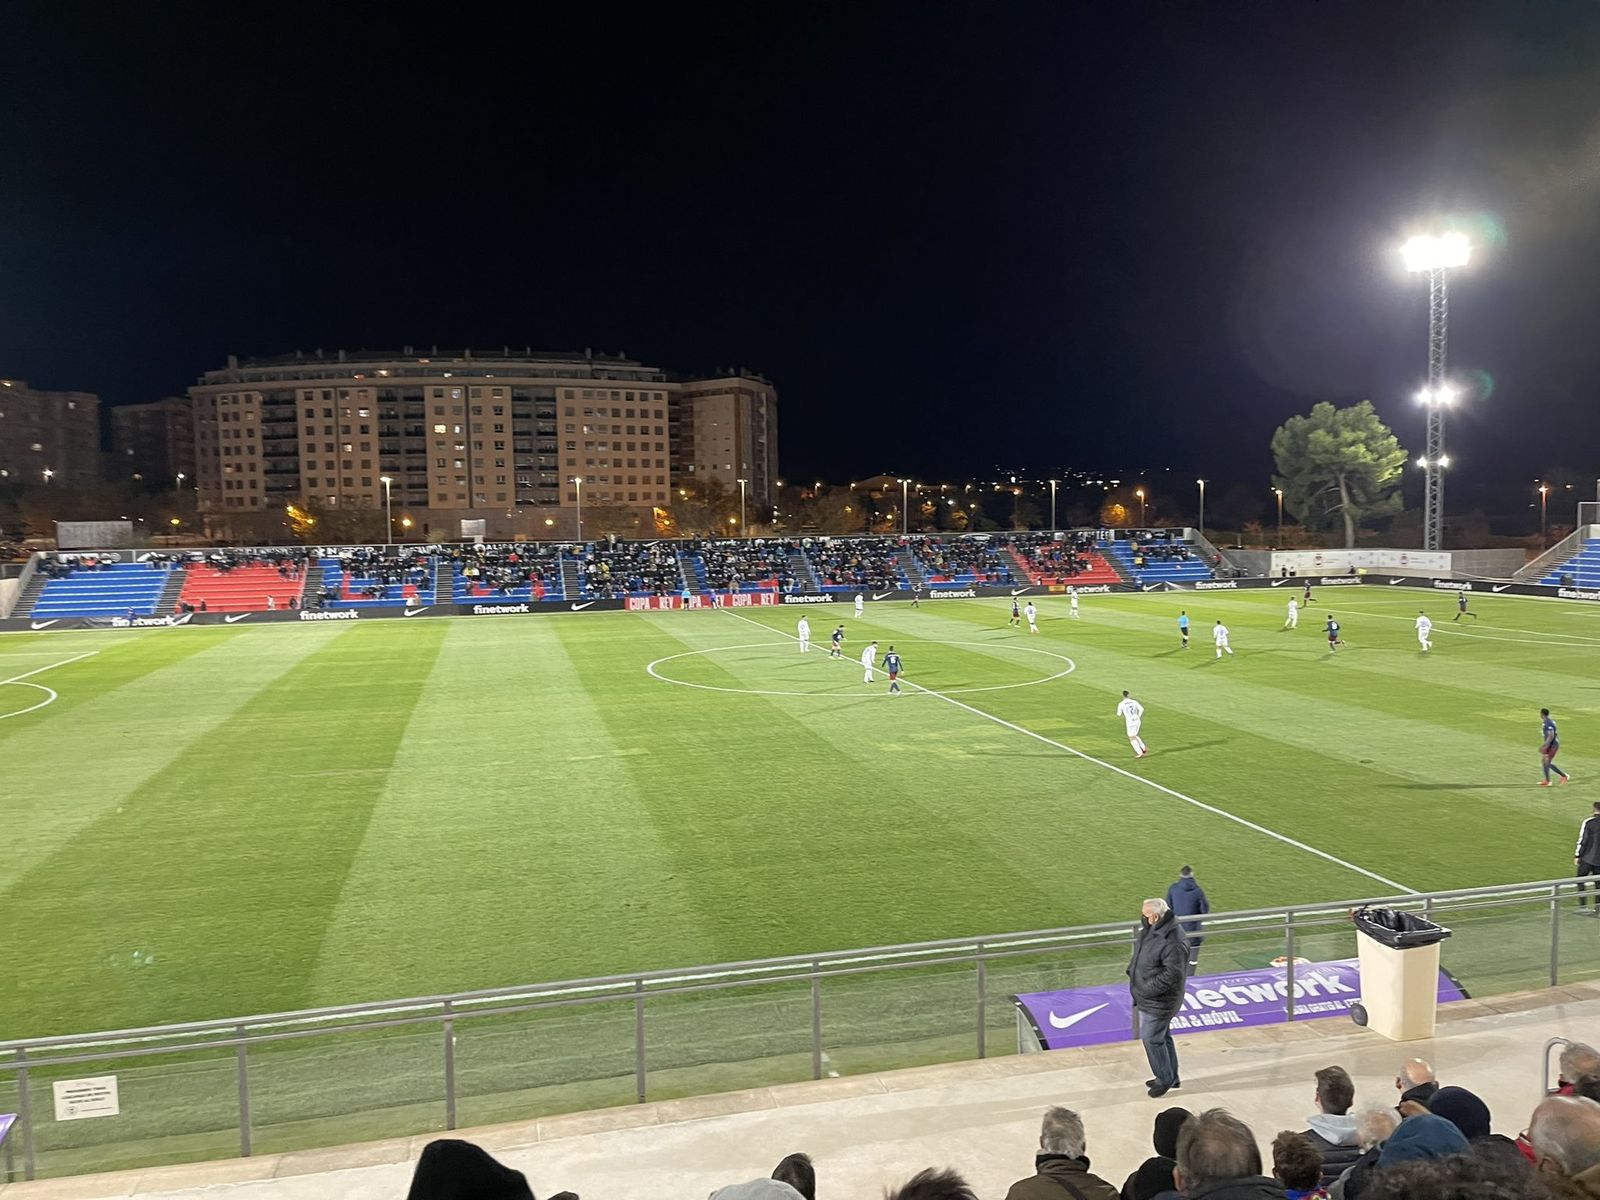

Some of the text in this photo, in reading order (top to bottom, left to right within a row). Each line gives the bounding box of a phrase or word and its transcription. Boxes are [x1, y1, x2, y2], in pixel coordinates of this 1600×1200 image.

[1195, 580, 1238, 590] finetwork
[1320, 576, 1362, 586] finetwork
[1433, 579, 1473, 591] finetwork
[784, 593, 833, 604] finetwork
[929, 588, 977, 599] finetwork
[629, 597, 650, 611] COPA
[688, 595, 702, 609] OPA
[732, 593, 753, 607] COPA
[299, 608, 359, 620] finetwork
[473, 603, 529, 614] finetwork
[1189, 1014, 1204, 1027] &
[1199, 1010, 1244, 1026] MÓVIL
